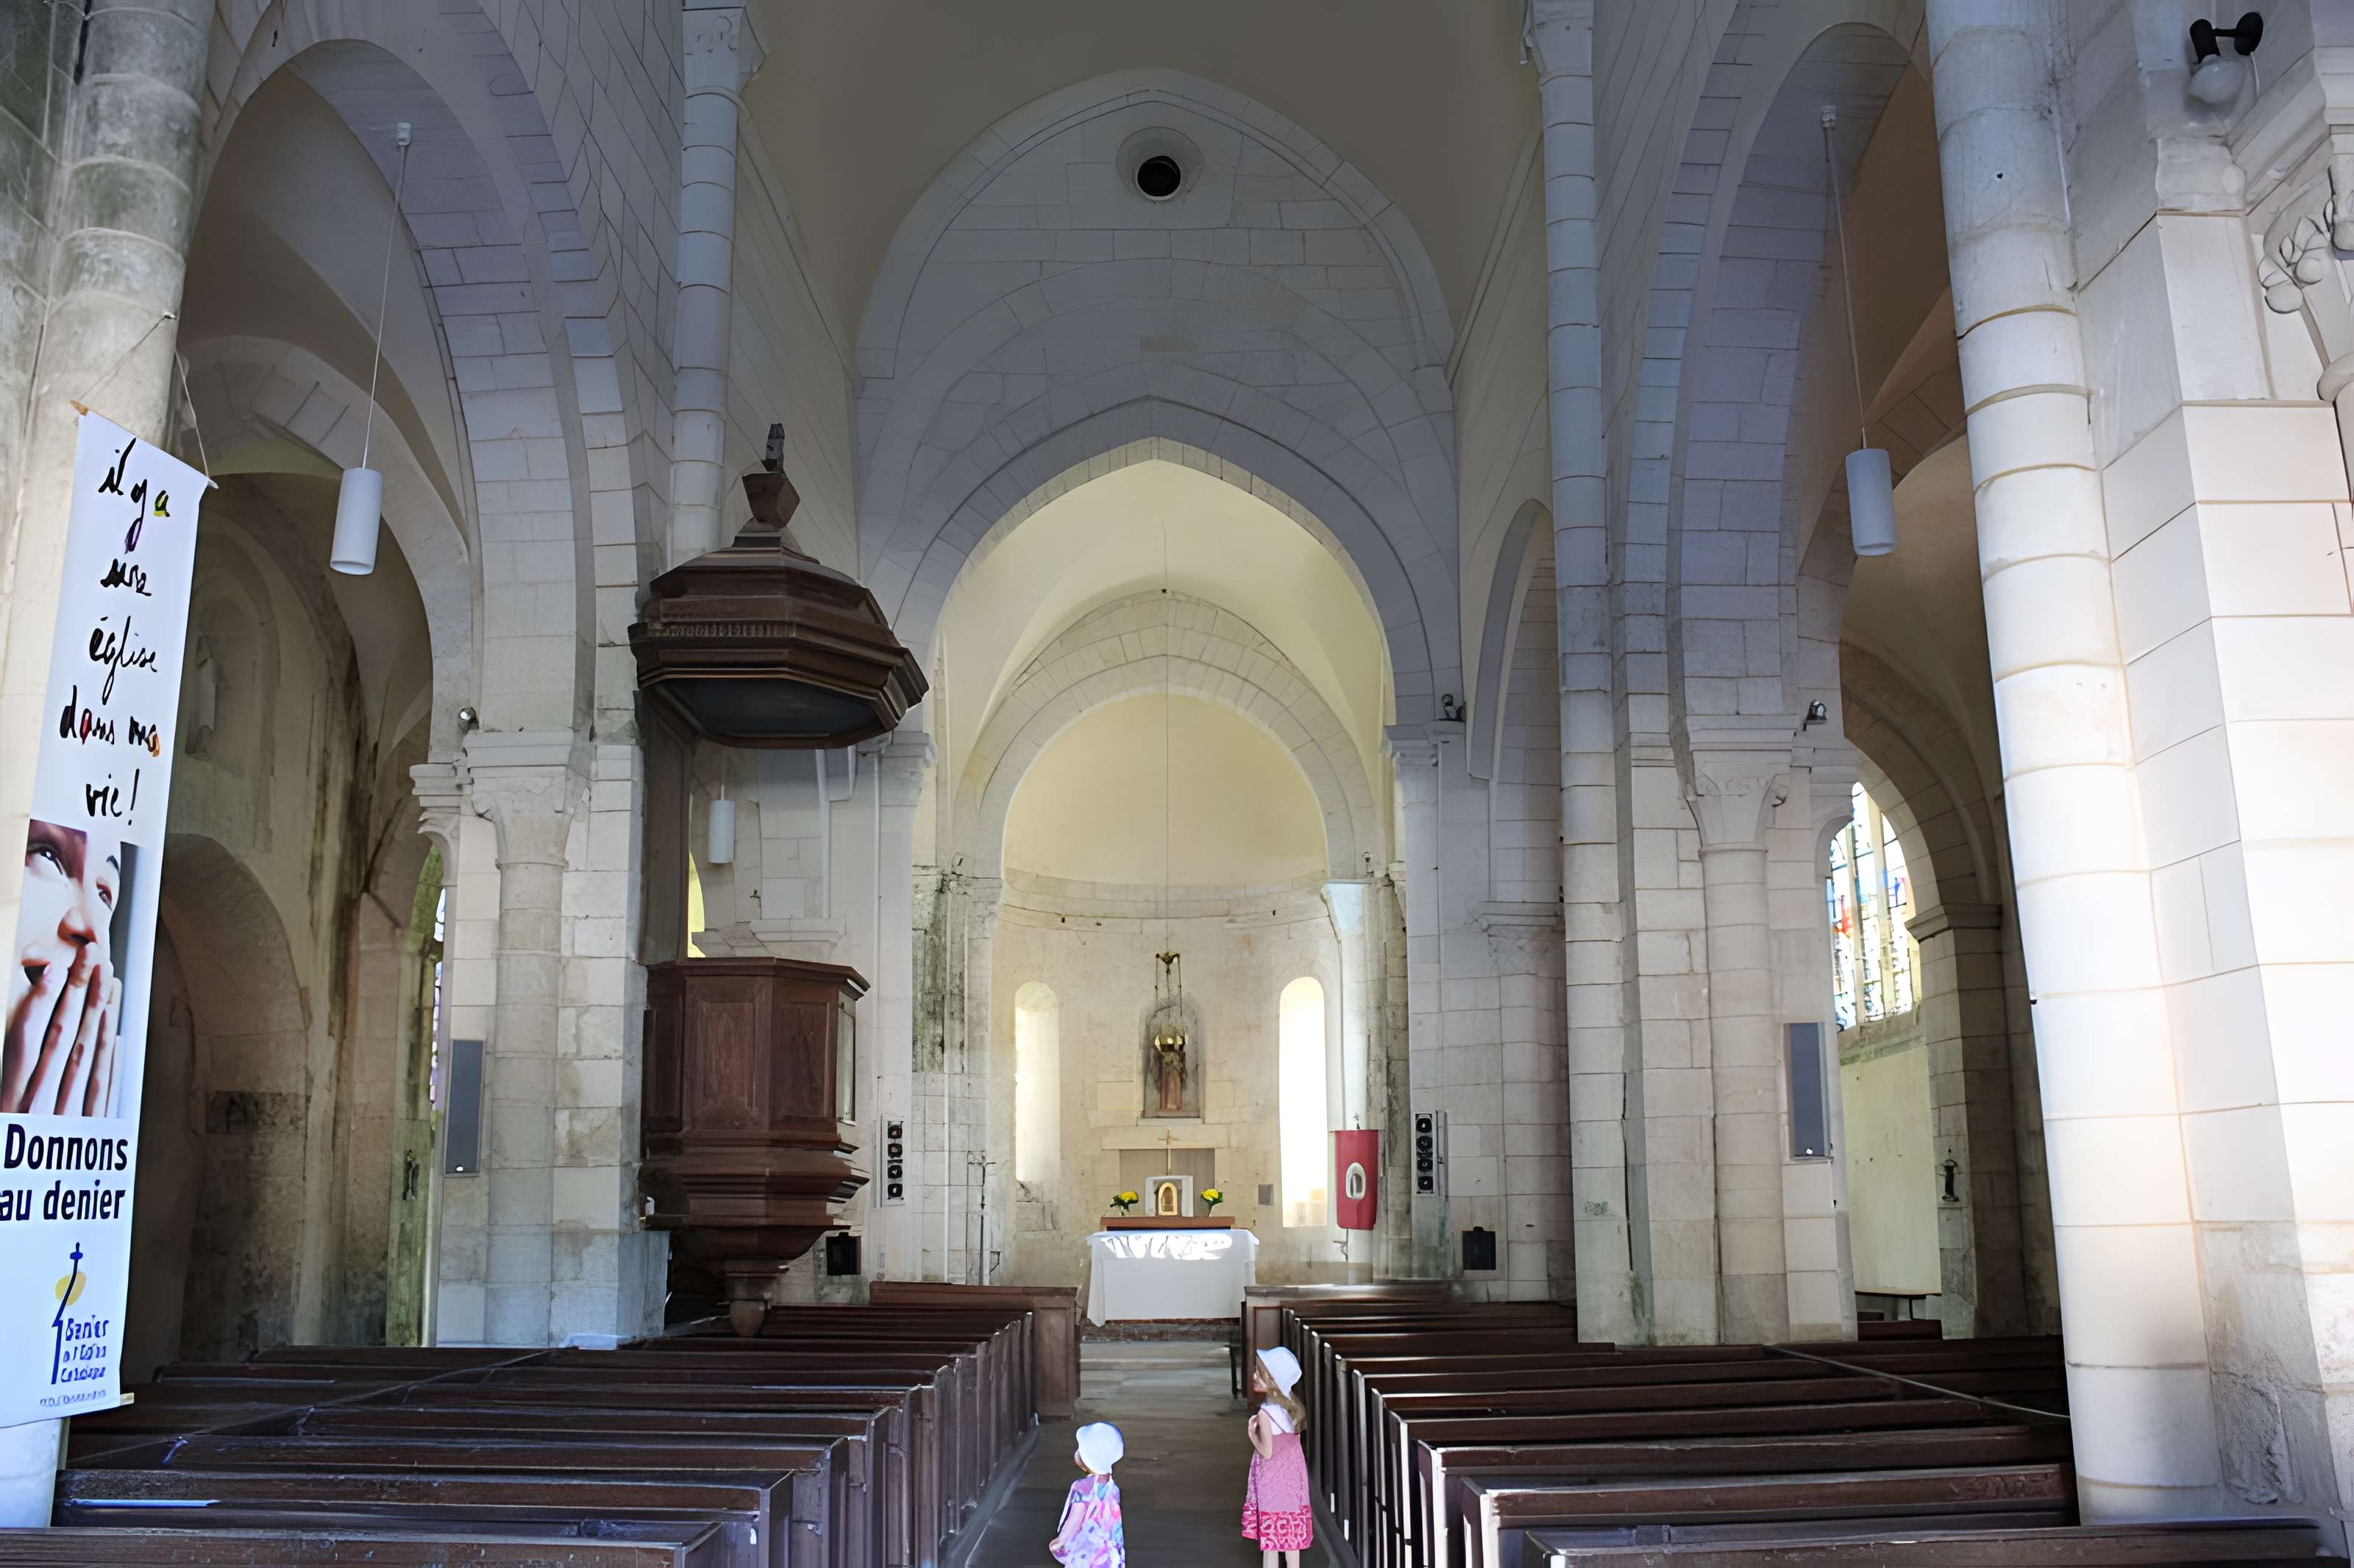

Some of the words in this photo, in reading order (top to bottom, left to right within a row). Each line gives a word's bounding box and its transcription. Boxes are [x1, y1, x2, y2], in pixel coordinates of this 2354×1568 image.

[98, 438, 136, 496] il
[124, 479, 147, 555] y
[153, 490, 170, 517] a
[90, 616, 157, 705] église
[60, 685, 115, 745] dans
[4, 1124, 128, 1171] Donnons
[0, 1190, 32, 1221] au
[43, 1180, 126, 1220] denier
